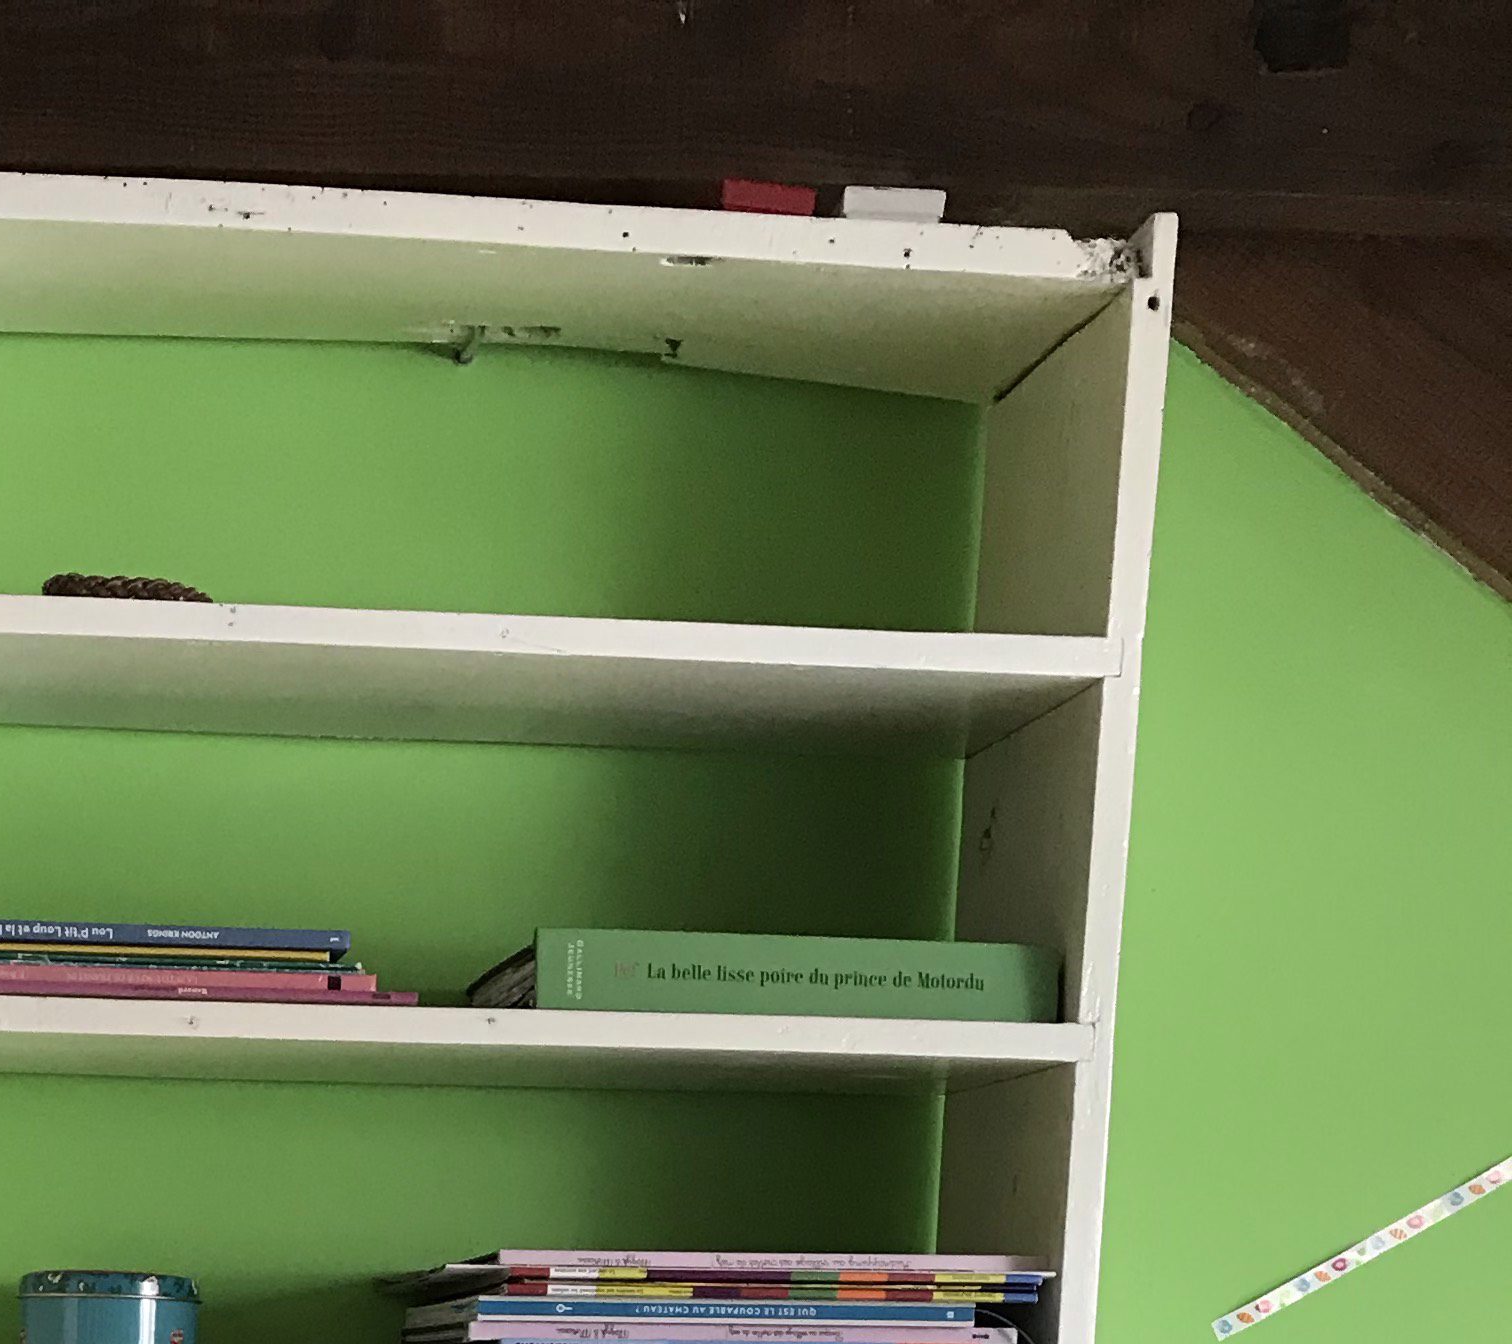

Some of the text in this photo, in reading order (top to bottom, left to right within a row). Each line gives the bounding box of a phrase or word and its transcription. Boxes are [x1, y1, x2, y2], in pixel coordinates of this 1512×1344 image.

[5, 924, 16, 935] la
[17, 924, 31, 935] et
[32, 923, 62, 937] Loup
[64, 926, 91, 938] P'tit
[91, 927, 114, 939] Lou
[147, 928, 221, 940] ANTOON KRINGS
[575, 939, 585, 1000] GALLIMARD
[646, 962, 985, 992] La belle lisse poire du prince de Motordu
[691, 1305, 707, 1314] AU
[708, 1305, 761, 1315] COUPABLE
[763, 1306, 775, 1315] LE
[775, 1306, 795, 1315] EST
[797, 1306, 817, 1316] QUI
